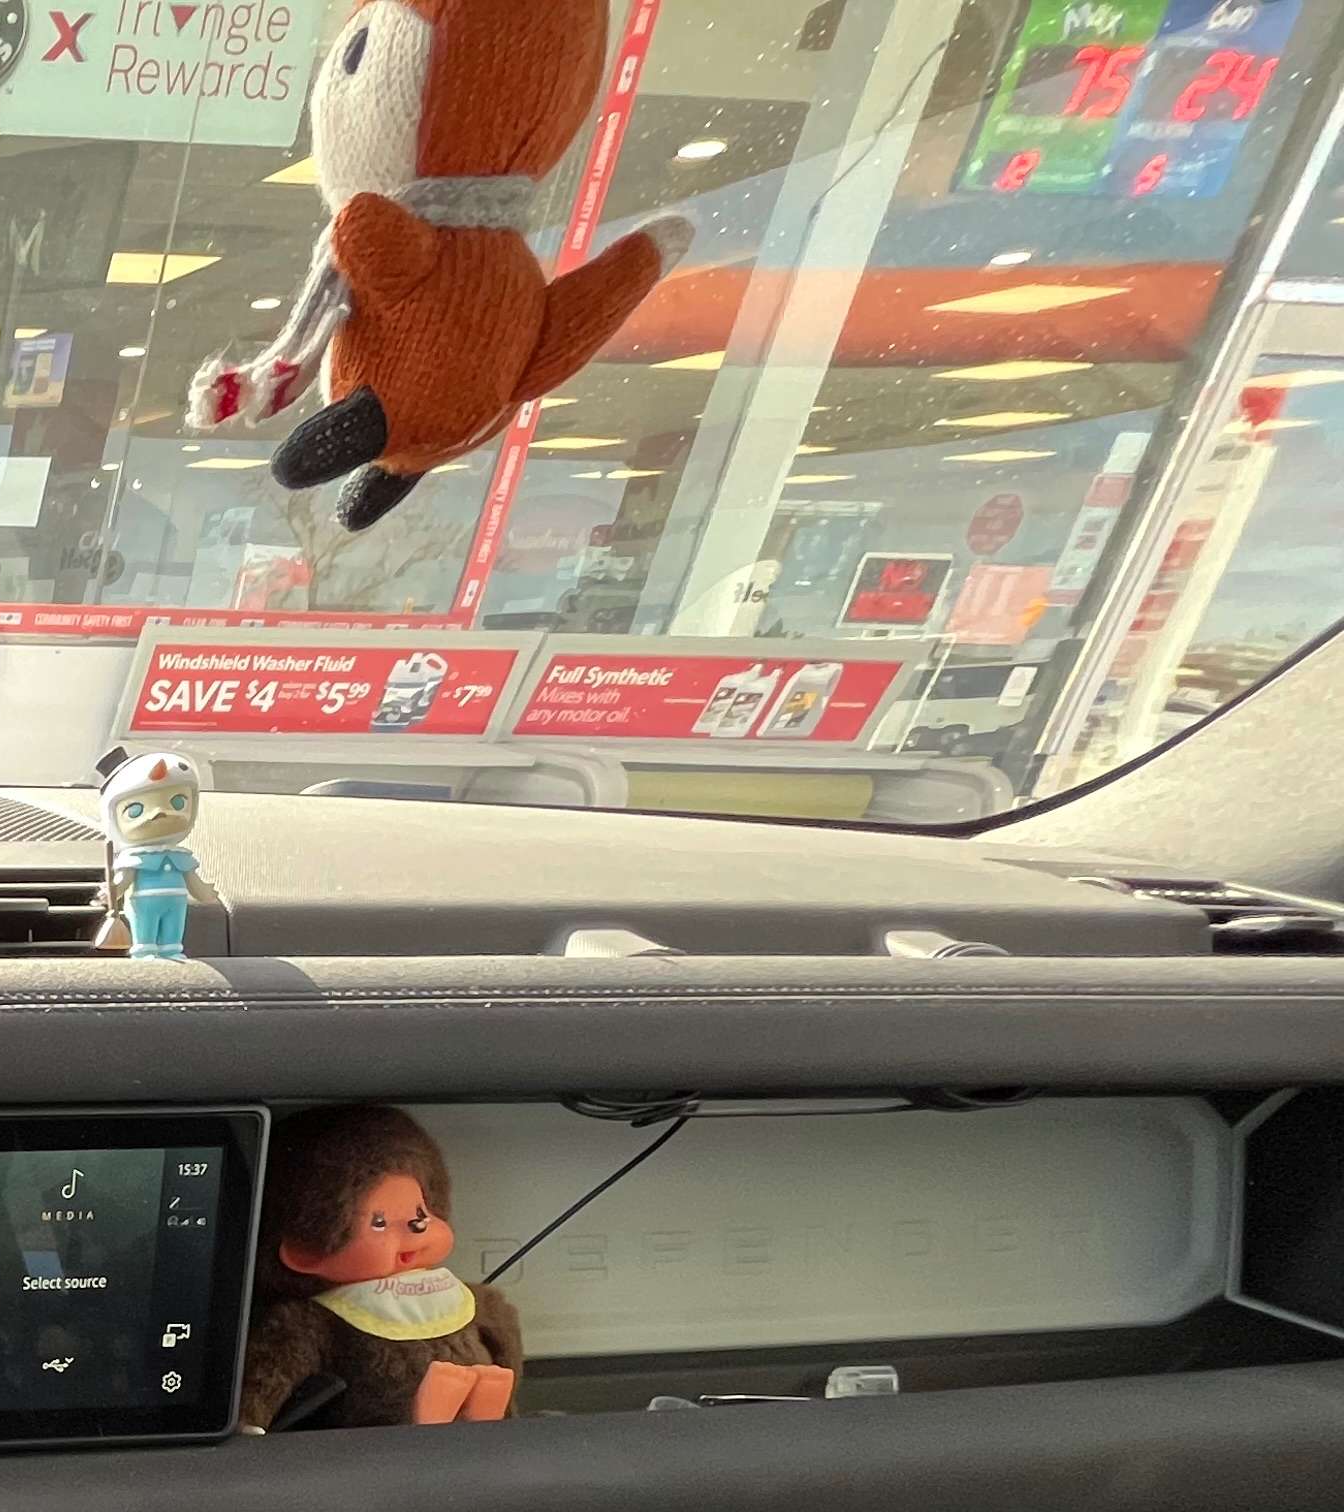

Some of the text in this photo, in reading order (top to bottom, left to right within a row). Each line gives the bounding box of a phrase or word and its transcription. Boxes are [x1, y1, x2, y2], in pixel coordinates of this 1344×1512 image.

[40, 11, 96, 63] X
[106, 43, 296, 101] Rewards
[1062, 44, 1147, 120] 75
[1173, 49, 1281, 122] 24
[34, 612, 133, 628] COMMUNITY SAFETY FIRST
[158, 652, 357, 673] Windshield Washer Fluid
[546, 665, 674, 687] Full Synthetic
[144, 679, 241, 713] SAVE
[246, 679, 279, 713] $4
[535, 686, 621, 705] Mixes with
[525, 709, 557, 724] any
[559, 707, 605, 723] motor
[178, 1163, 208, 1176] 15:37
[41, 1210, 94, 1221] MEDIA
[22, 1276, 108, 1291] Select source
